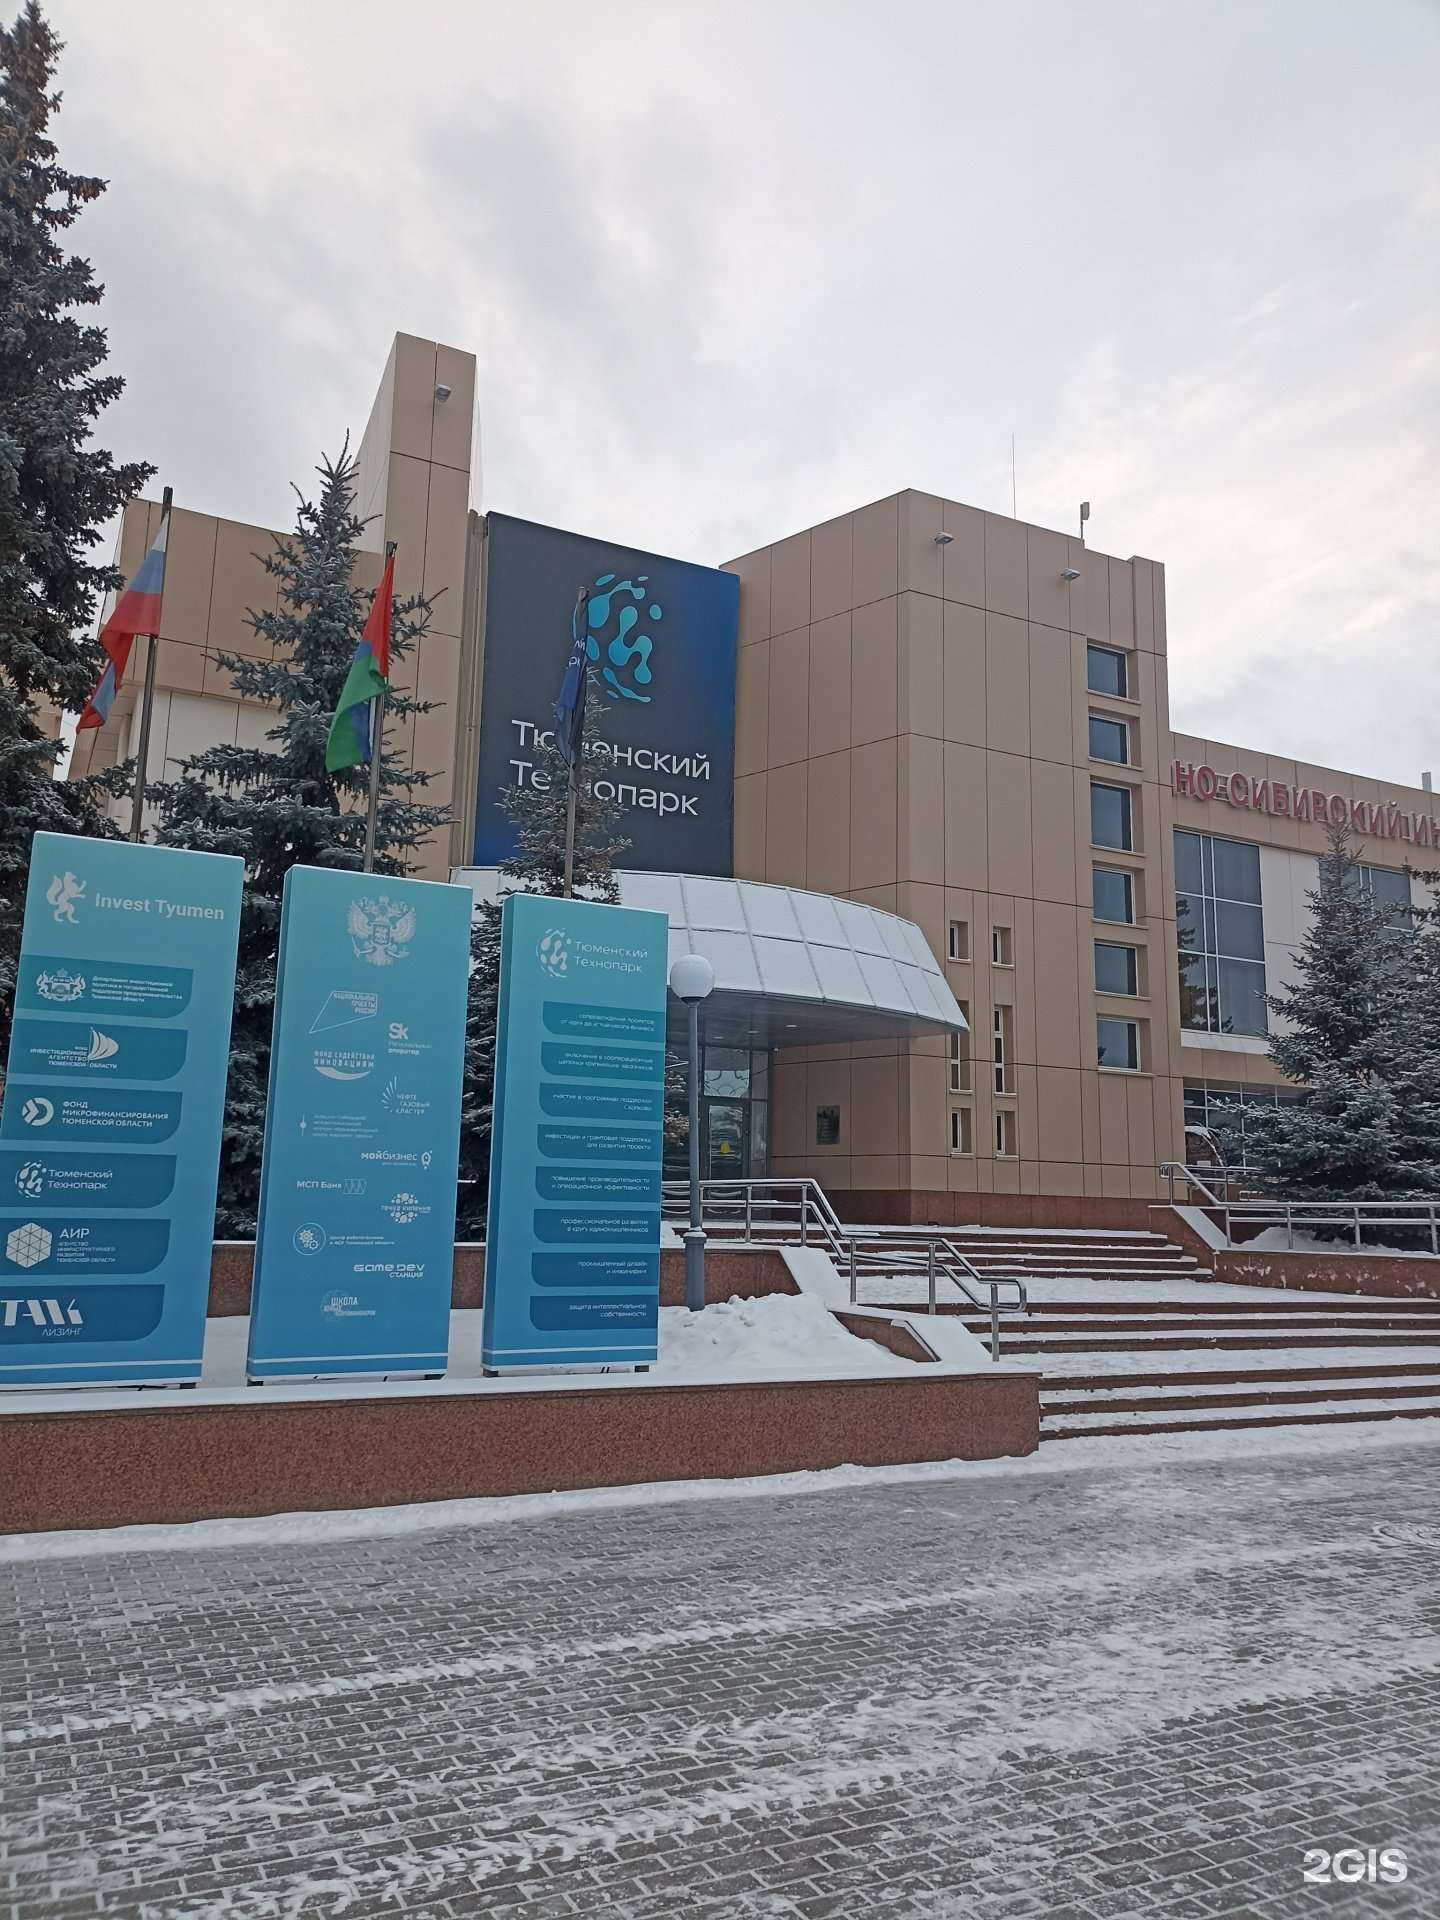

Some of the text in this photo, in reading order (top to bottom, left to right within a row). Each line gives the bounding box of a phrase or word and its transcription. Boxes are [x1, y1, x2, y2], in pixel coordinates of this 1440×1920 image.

[511, 719, 711, 780] Тюенский
[509, 759, 699, 816] Теопарк
[95, 892, 225, 920] Invest Tyumen
[575, 941, 648, 959] Тюменский
[574, 956, 643, 974] Технопарк
[388, 1022, 409, 1040] Sk
[48, 1054, 88, 1062] АГЕНТСТВО
[89, 1062, 118, 1070] ОБЛАСТИ
[62, 1100, 89, 1109] ФОНД
[62, 1109, 169, 1120] МИКРОФИНАНСИРОВАНИЯ
[62, 1117, 153, 1128] ТЮМЕНСКОЙ ОБЛАСТИ
[48, 1169, 113, 1179] Тюменский
[47, 1180, 108, 1191] Технопарк
[296, 1180, 319, 1189] МСП
[60, 1228, 90, 1239] АИР
[331, 1296, 358, 1306] ШКОЛА
[42, 1327, 83, 1337] ЛИЗИНГ
